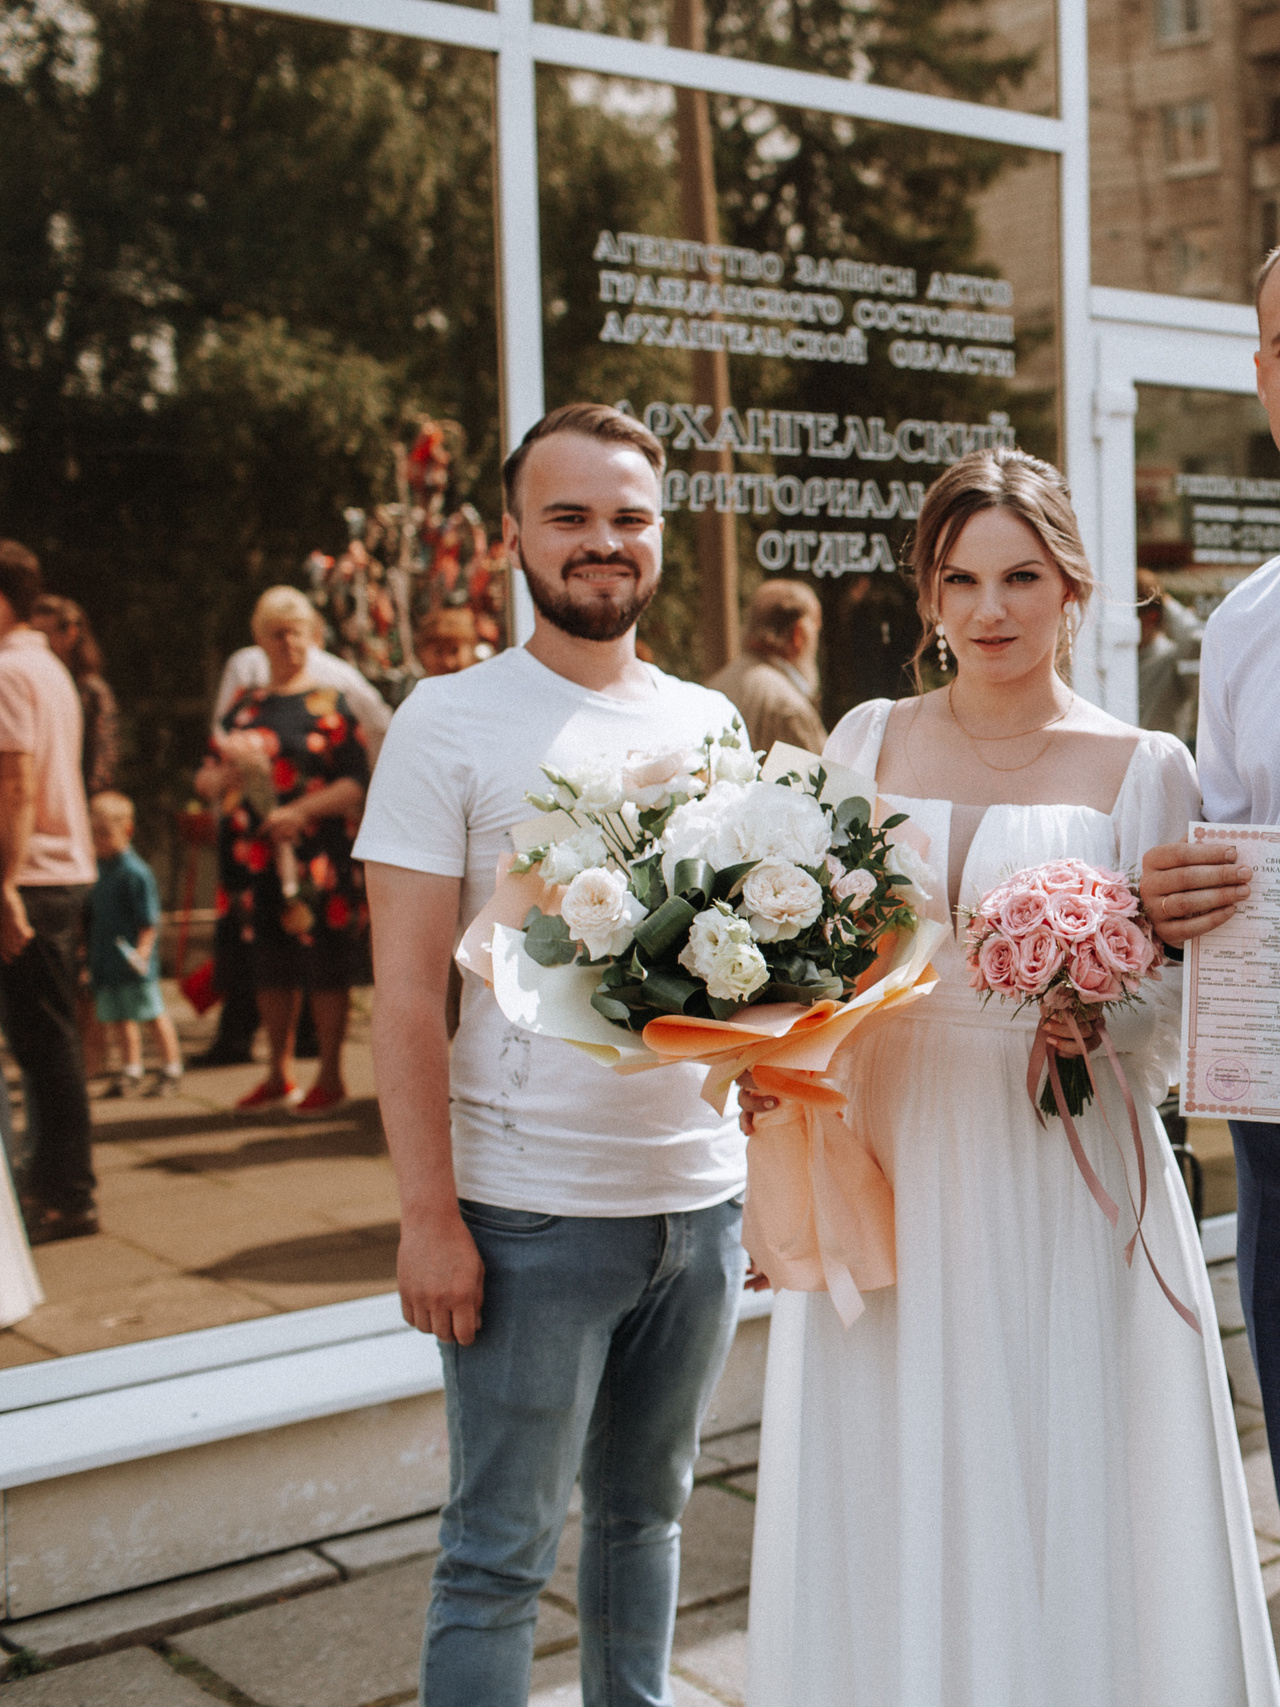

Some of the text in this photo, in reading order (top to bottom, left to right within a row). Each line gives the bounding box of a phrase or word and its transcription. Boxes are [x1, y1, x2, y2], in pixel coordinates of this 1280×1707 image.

[593, 229, 785, 283] АГЕНТСТВО
[925, 271, 1014, 308] АКТОВ
[598, 269, 844, 325] ГРАЖДАНСКОГО
[599, 310, 1016, 378] АРХАНГЕЛЬСКОЙ ОБЛАСТИ
[756, 529, 897, 579] ОТДЕЛ
